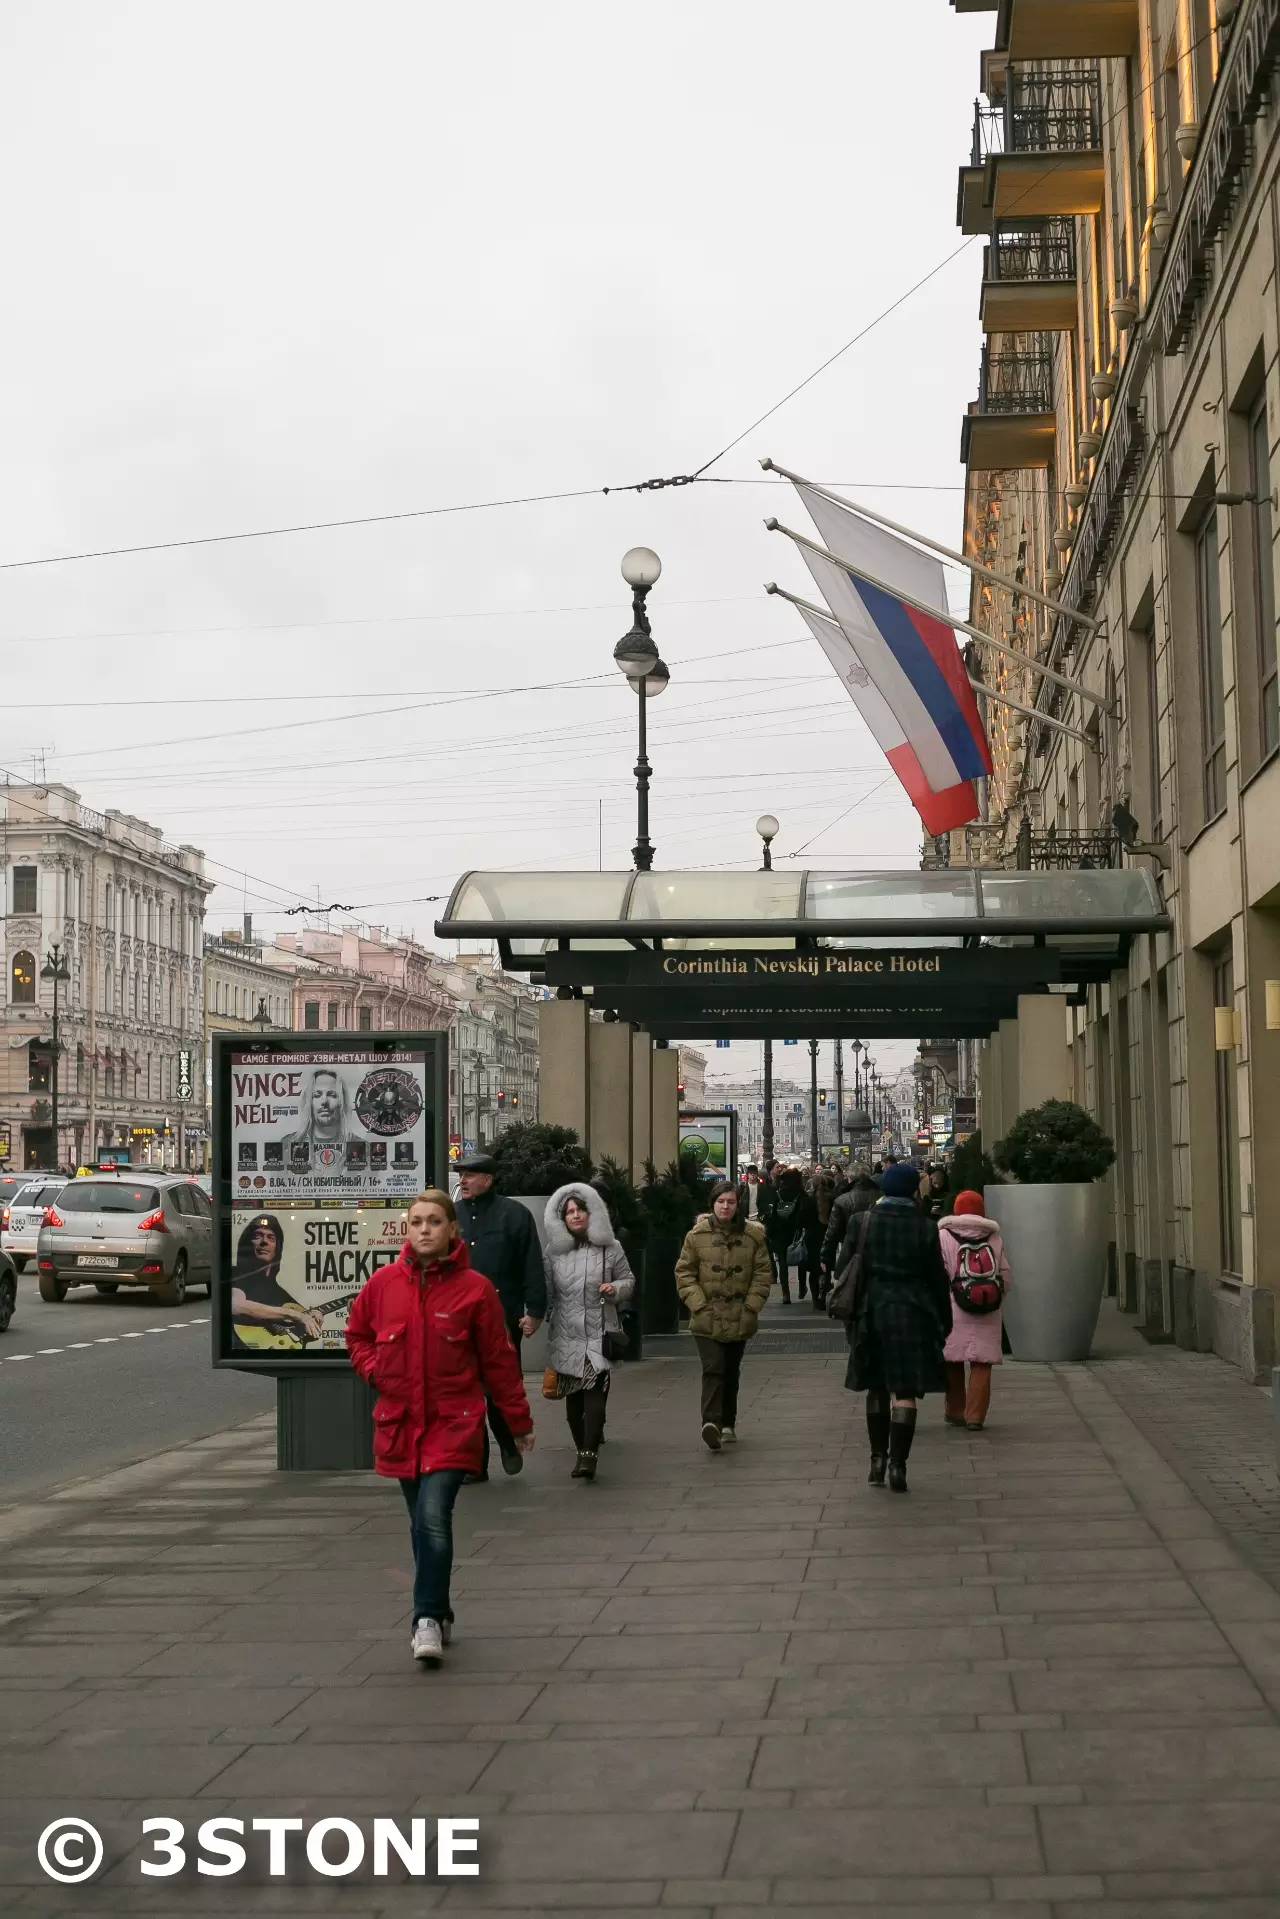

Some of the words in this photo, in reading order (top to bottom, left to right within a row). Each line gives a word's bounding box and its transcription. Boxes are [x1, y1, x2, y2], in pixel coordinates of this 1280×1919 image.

[663, 956, 748, 973] Corinthia
[754, 957, 819, 976] Nevskij
[825, 956, 884, 972] Palace
[890, 956, 940, 972] Hotel
[241, 1054, 268, 1063] САМОЕ
[272, 1053, 309, 1063] ГРОМКОЕ
[313, 1053, 366, 1062] ХЭВИ-МЕТАЛ
[368, 1053, 388, 1062] ШОУ
[391, 1053, 412, 1062] 2014!
[269, 1177, 297, 1188] 8.04.14
[313, 1174, 362, 1187] ЮБИЛЕЙНЫЙ
[368, 1176, 381, 1187] 16+
[232, 1214, 249, 1225] 12+
[304, 1221, 359, 1246] STEVE
